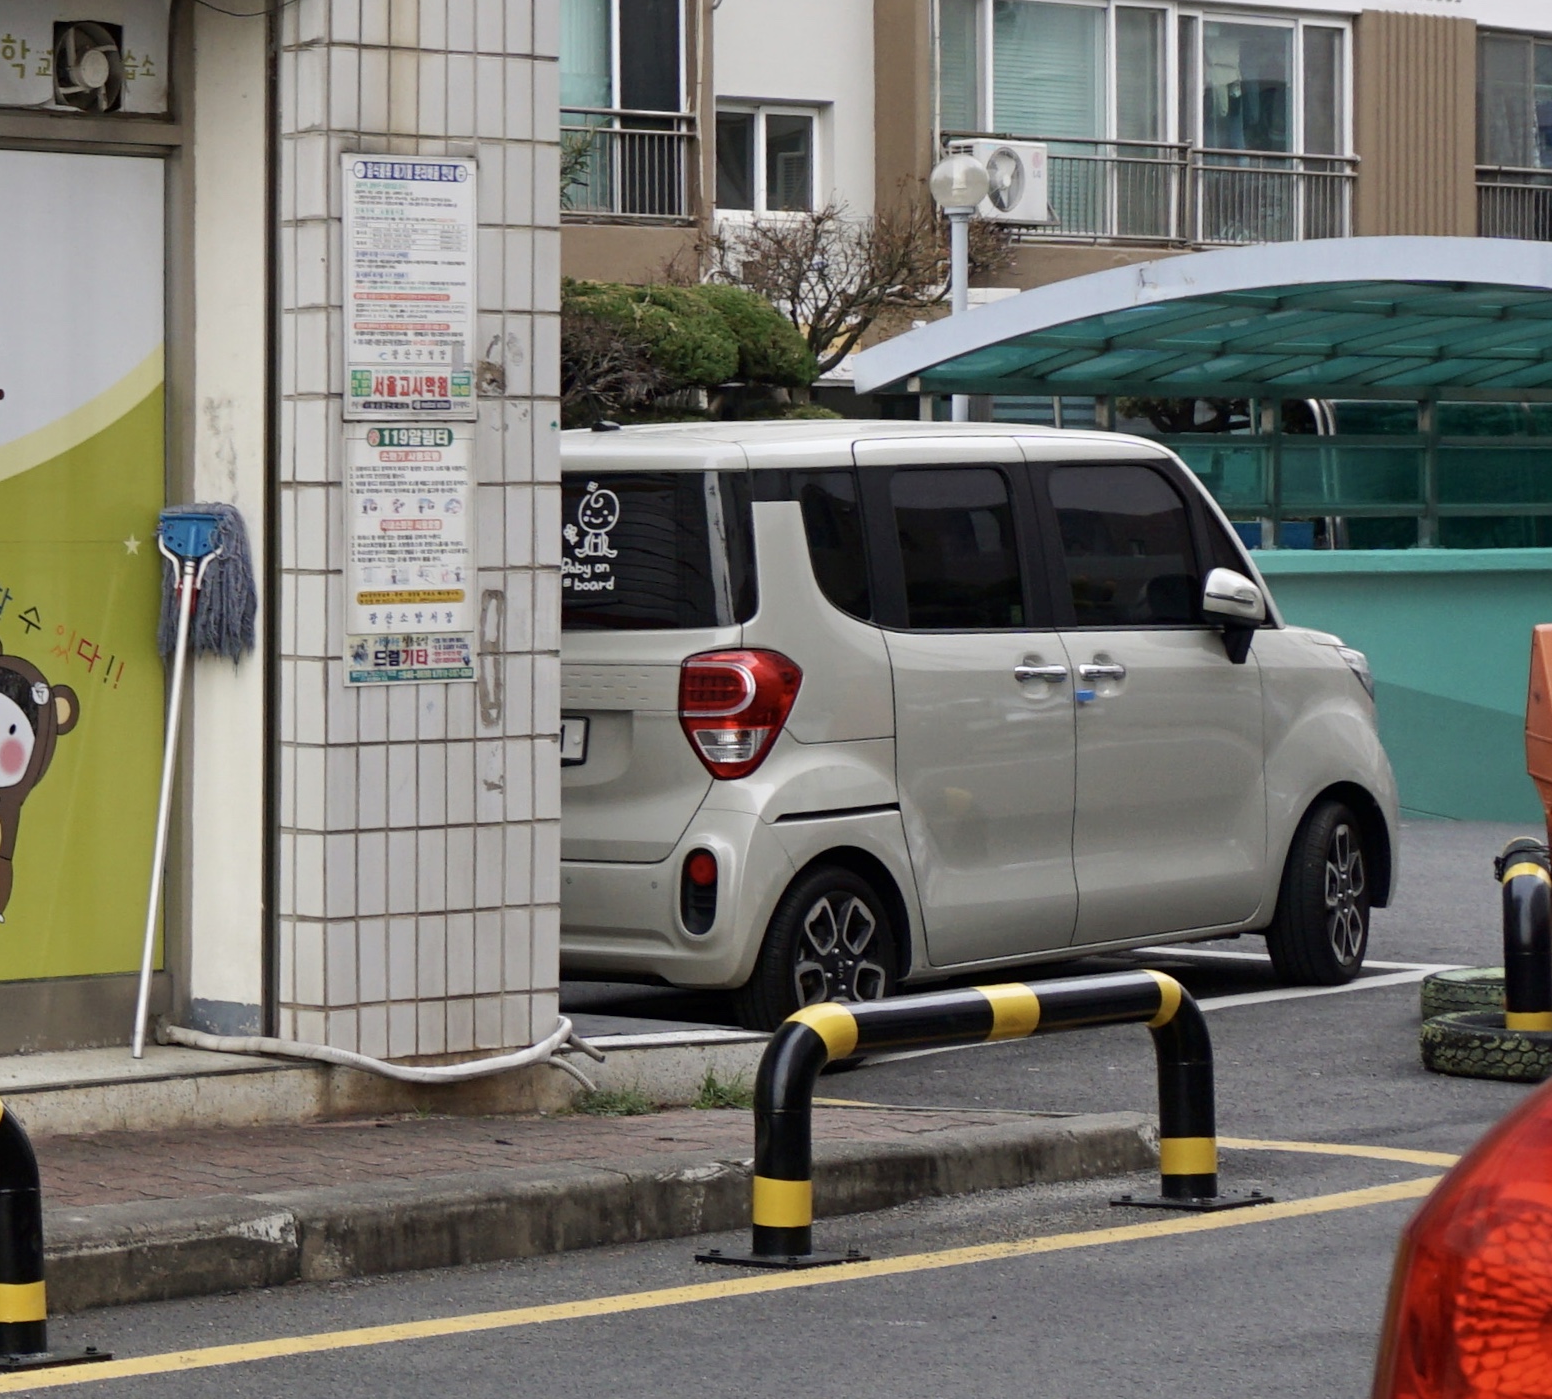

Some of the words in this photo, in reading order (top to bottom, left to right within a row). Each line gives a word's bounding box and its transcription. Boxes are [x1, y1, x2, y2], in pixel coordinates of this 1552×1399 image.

[382, 429, 449, 447] 119알림터
[561, 557, 592, 579] Baby
[594, 563, 611, 573] on
[574, 576, 615, 591] board
[18, 606, 42, 634] 수
